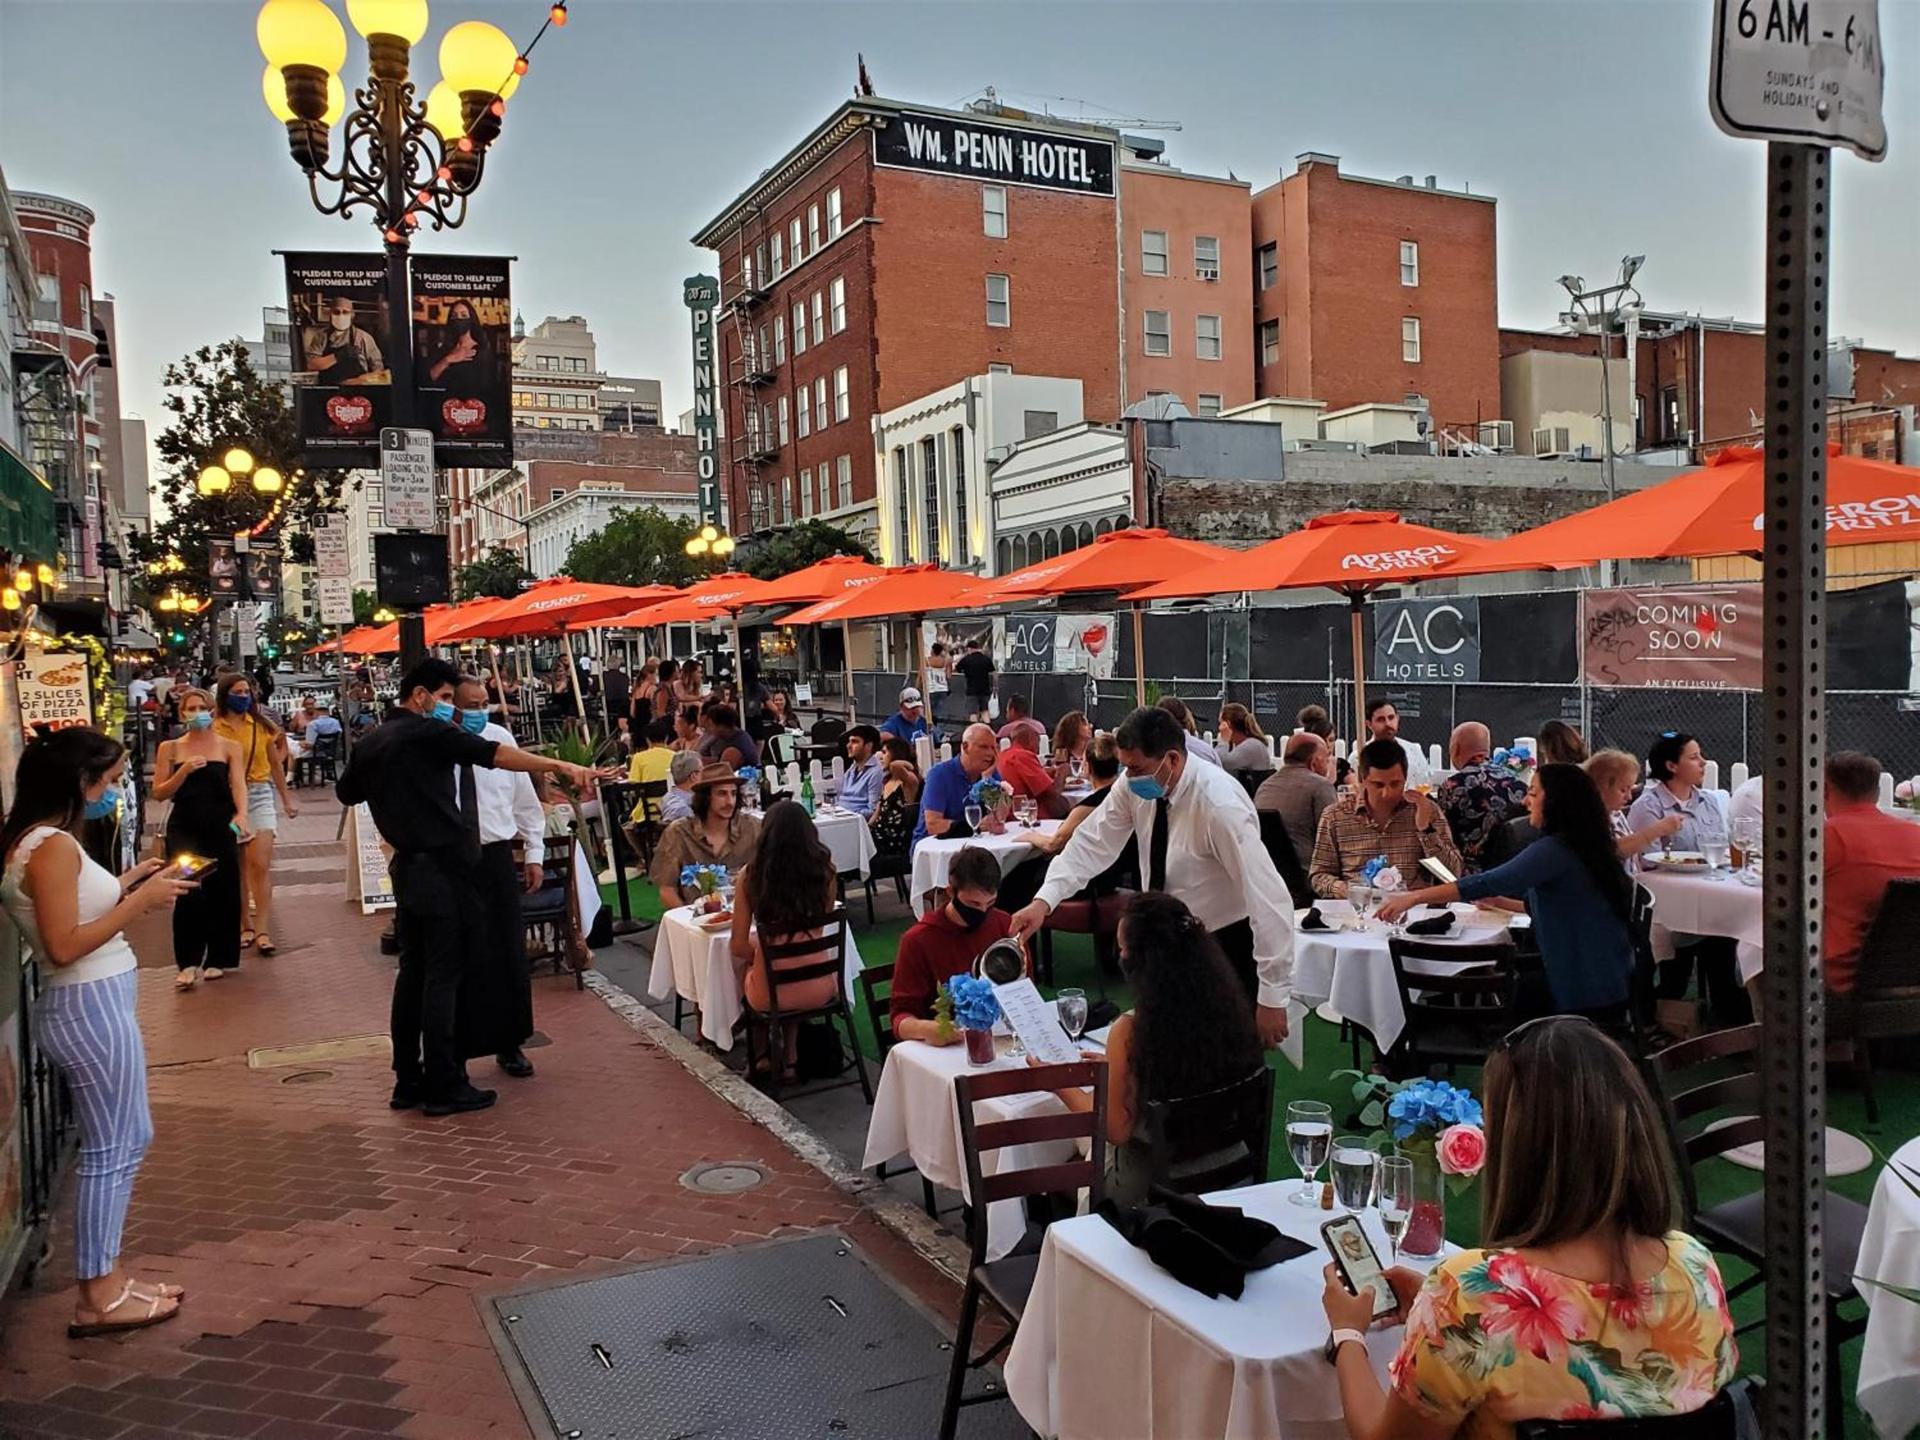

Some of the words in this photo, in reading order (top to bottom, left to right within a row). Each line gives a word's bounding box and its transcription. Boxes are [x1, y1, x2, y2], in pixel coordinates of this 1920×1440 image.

[1738, 0, 1757, 39] 6
[1765, 0, 1809, 46] AM
[1766, 71, 1815, 90] SUNDAYS
[1820, 80, 1840, 96] AND
[954, 130, 1013, 173] PENN
[1022, 140, 1093, 184] HOTEL
[302, 270, 331, 278] PLEDGE
[423, 273, 452, 281] PLEDGE
[425, 282, 471, 290] CUSTOMERS
[694, 309, 711, 417] PENN
[390, 432, 398, 448] 3
[406, 437, 430, 448] MINUTE
[390, 453, 425, 463] PASSENGER
[386, 463, 412, 473] LOADING
[414, 465, 430, 474] ONLY
[699, 427, 715, 526] HOTE
[1342, 544, 1457, 569] APEROL
[1637, 603, 1738, 625] COMING
[1387, 605, 1465, 655] AC
[1012, 622, 1049, 656] AC
[1649, 630, 1722, 650] SOON
[1010, 661, 1047, 671] HOTELS
[1386, 663, 1465, 678] HOTELS
[22, 691, 30, 700] 2
[34, 689, 82, 700] SLICES
[20, 701, 39, 709] OF
[44, 698, 86, 709] PIZZA
[42, 708, 79, 718] BEER
